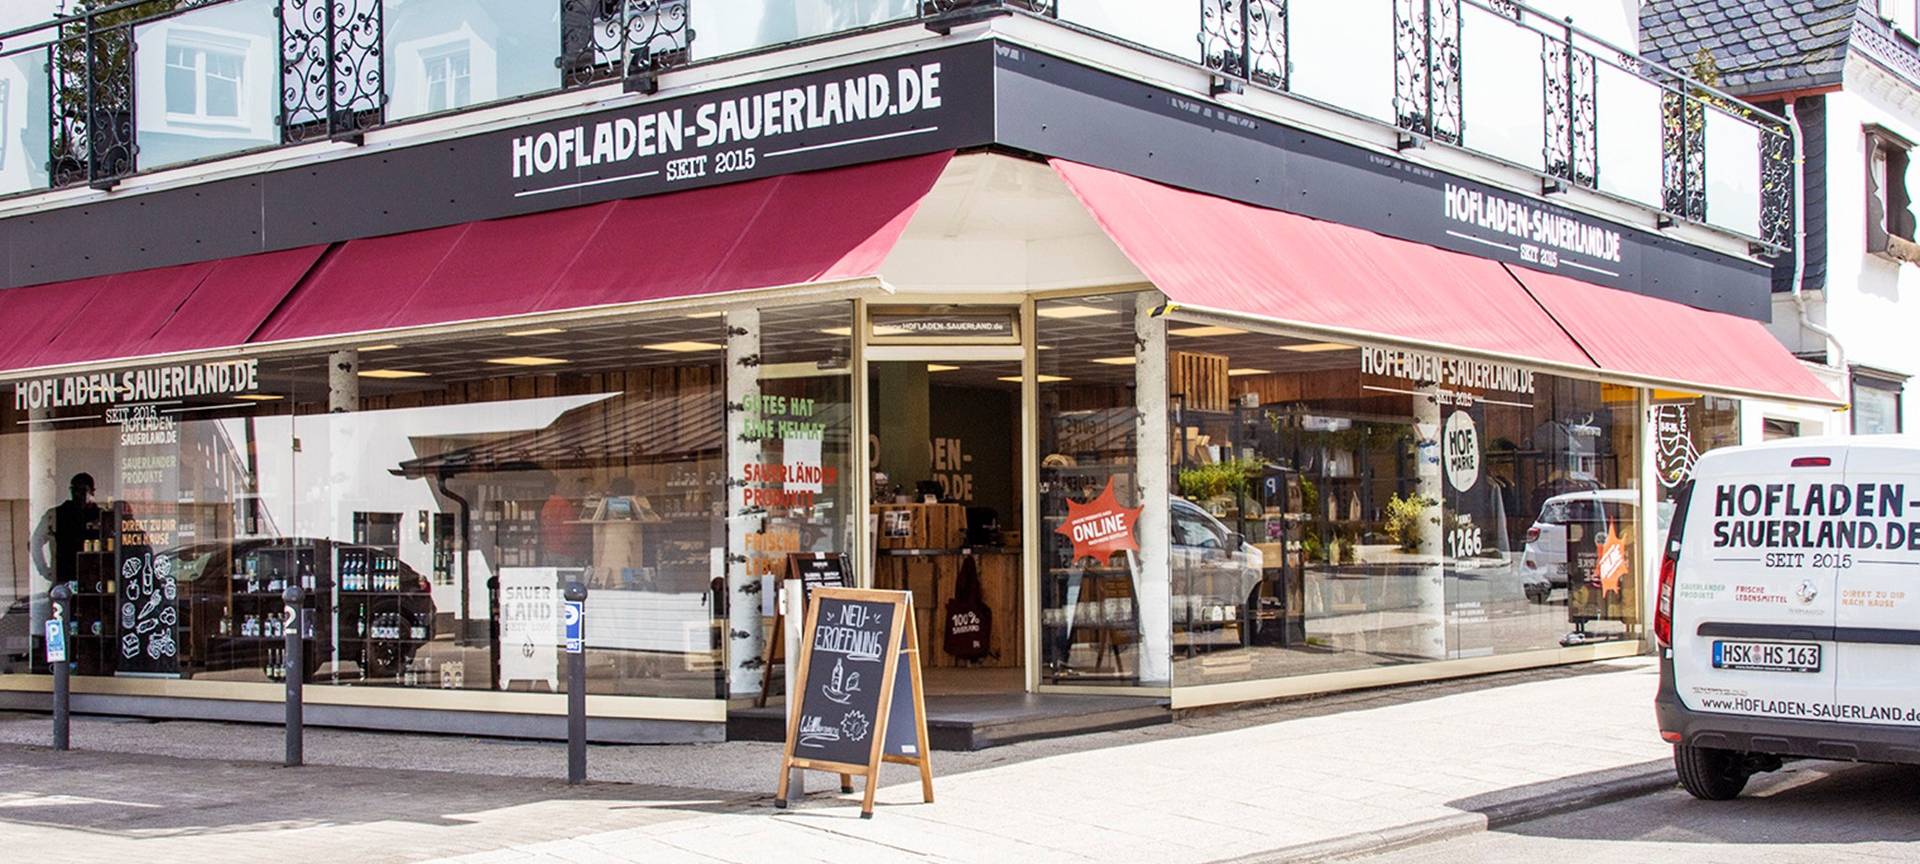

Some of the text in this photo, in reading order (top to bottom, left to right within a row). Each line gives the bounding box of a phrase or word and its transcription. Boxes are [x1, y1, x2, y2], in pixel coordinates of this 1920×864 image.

[512, 62, 942, 178] HOFLADEN-SAUERLAND.DE
[666, 147, 756, 182] SEIT 2015
[1444, 182, 1621, 263] HOFLADEN-SAUERLAND.DE
[1520, 243, 1558, 267] SEIT 2015
[1361, 346, 1535, 394] HOFLADEN-SAUERLAND.DE
[15, 358, 259, 410] HOFLADEN-SAUERLAND.DE
[105, 404, 157, 424] SEIT 2015
[742, 394, 815, 417] GUTES HAT
[121, 430, 177, 446] SAUERLAND.DE
[744, 418, 826, 440] EINE HEIMAT
[743, 461, 838, 485] SAUERLÄNDER
[1451, 455, 1475, 472] MARKE
[743, 488, 815, 509] PRODUKTE
[1714, 482, 1920, 518] HOFLADEN-
[121, 518, 177, 533] DIREKT ZU DIR
[1072, 513, 1127, 543] ONLINE
[1713, 520, 1920, 551] SAUERLAND.DE
[1447, 528, 1482, 559] 1266
[1765, 553, 1852, 569] SEIT 2015
[506, 586, 551, 600] SAUER
[1735, 585, 1765, 594] FRISCHE
[1735, 594, 1788, 604] LEBENSMITTEL
[1842, 590, 1872, 599] DIREKT
[1890, 591, 1905, 600] DIR
[505, 602, 551, 621] LAND
[1842, 599, 1895, 608] NACH HAUSE
[284, 605, 298, 634] 2
[839, 604, 870, 628] NEU-
[952, 611, 981, 627] 100%
[50, 624, 60, 642] P
[1723, 644, 1817, 666] HSK HS 163
